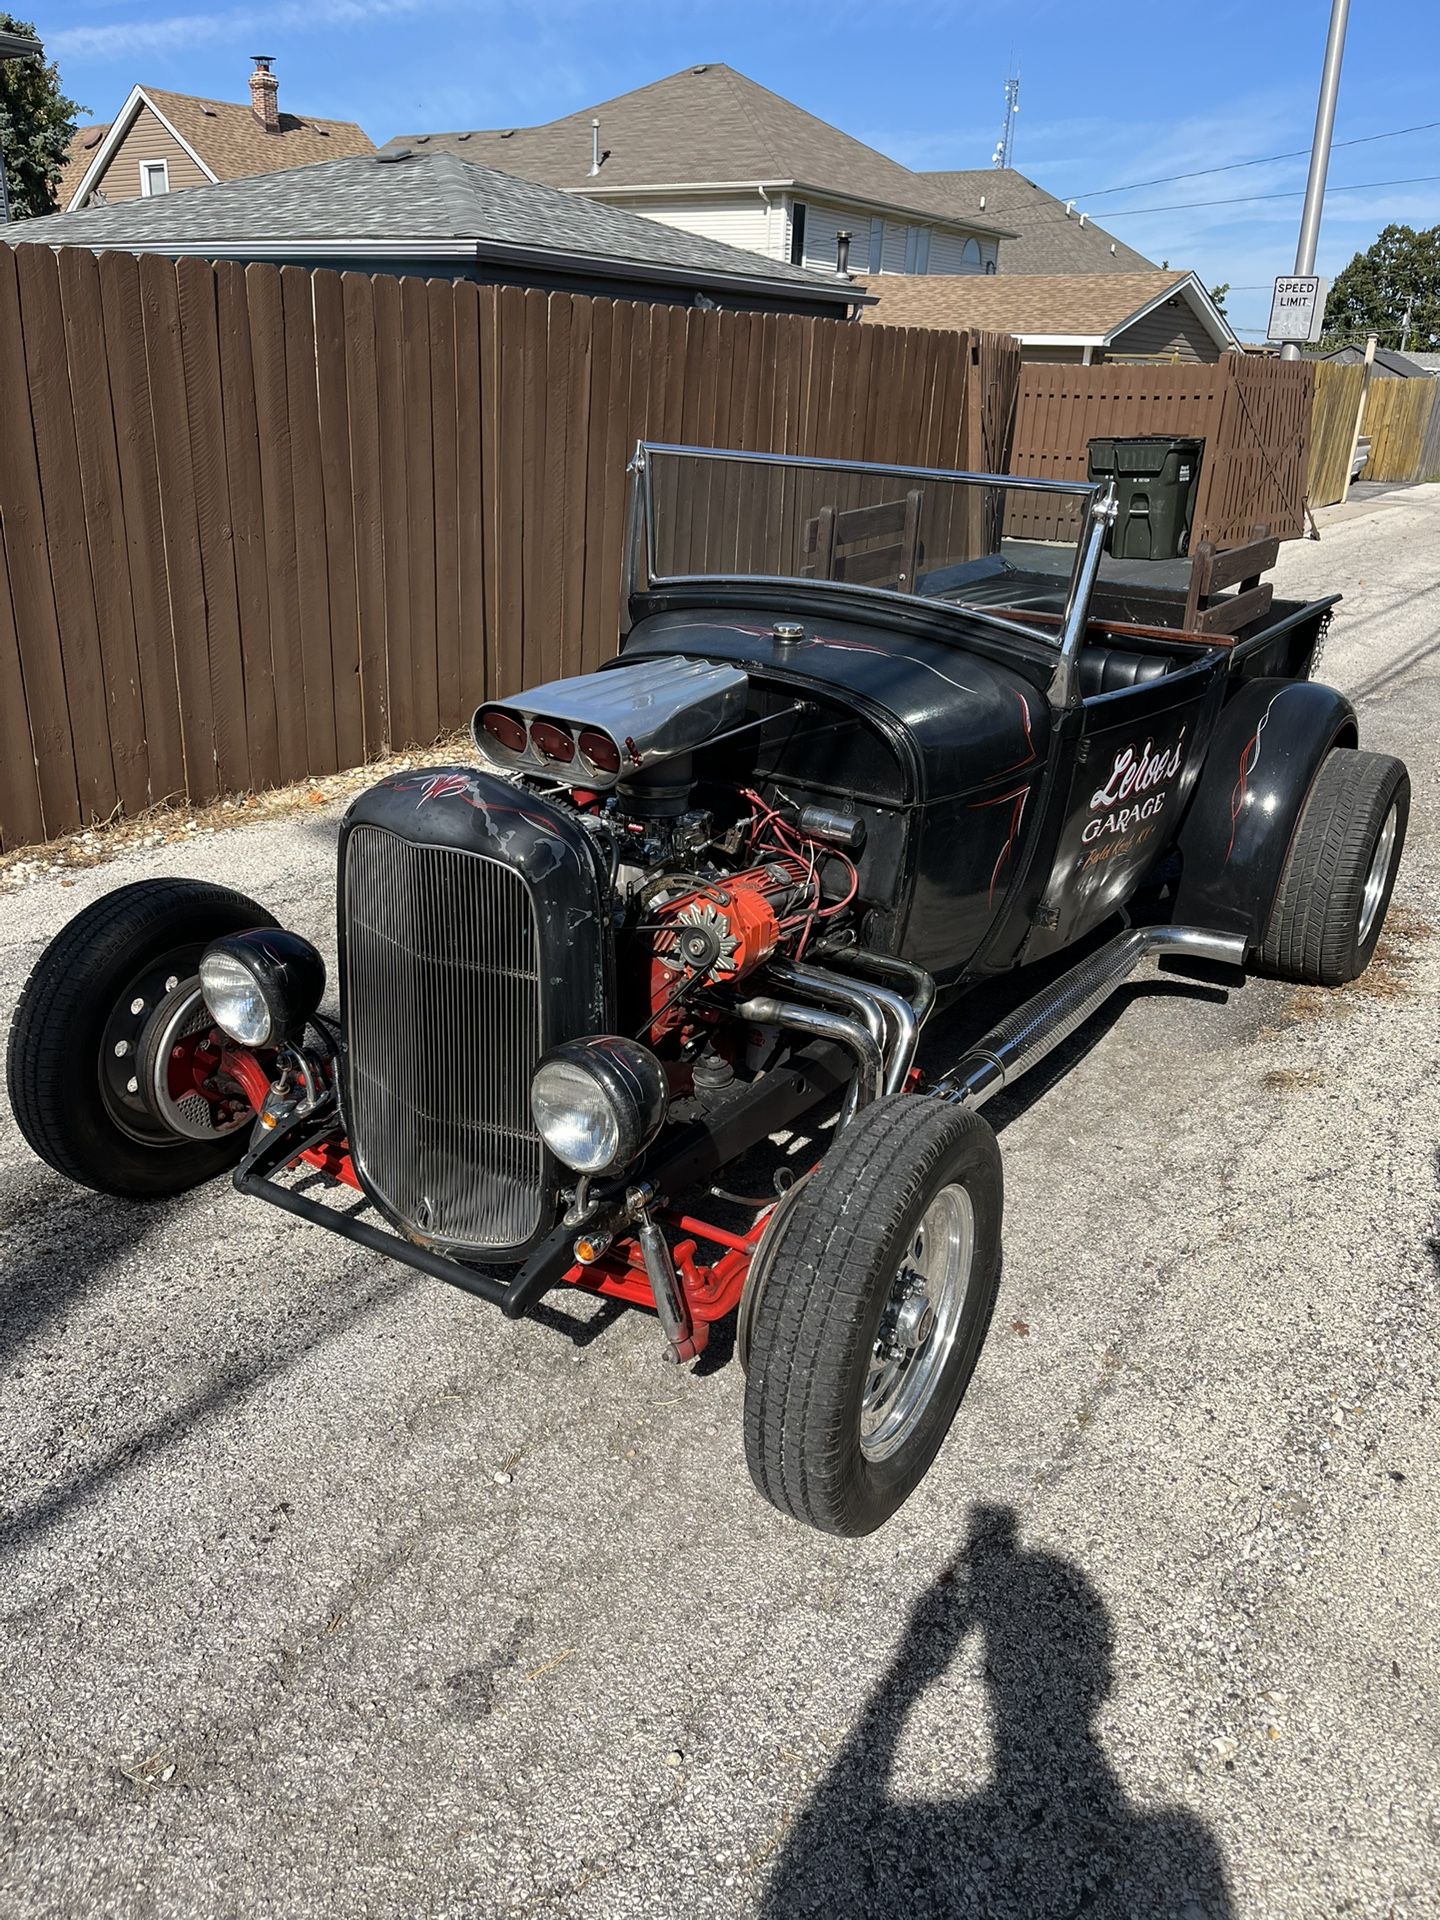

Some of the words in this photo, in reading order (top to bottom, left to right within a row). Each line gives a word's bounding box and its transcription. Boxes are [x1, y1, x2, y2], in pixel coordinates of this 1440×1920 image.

[1278, 283, 1314, 293] SPEED
[1280, 297, 1308, 307] LIMIT
[1081, 792, 1166, 843] GARAGE
